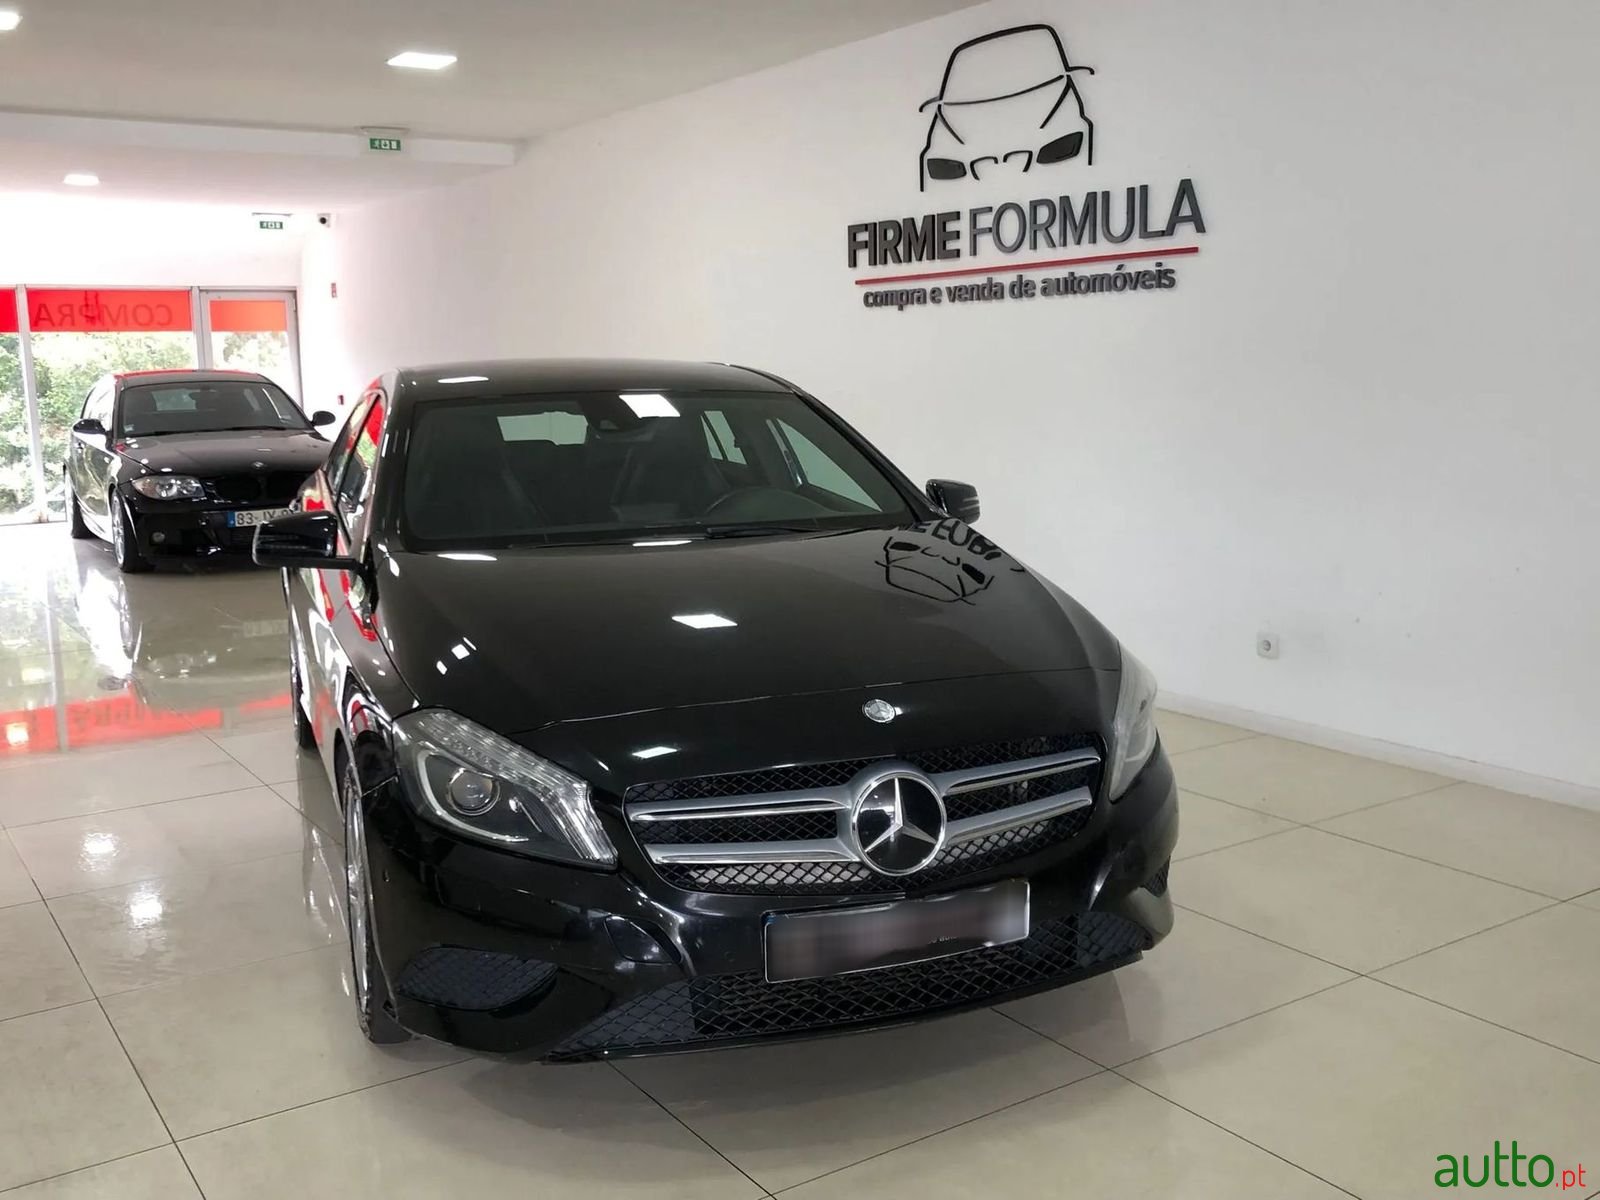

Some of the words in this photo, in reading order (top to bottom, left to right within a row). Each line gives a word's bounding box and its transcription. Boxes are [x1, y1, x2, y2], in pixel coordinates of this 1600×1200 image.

[848, 210, 961, 268] FIRME
[969, 178, 1207, 256] FORMULA
[863, 285, 928, 311] compra
[930, 286, 942, 304] e
[946, 276, 1005, 304] venda
[1009, 273, 1036, 299] de
[1040, 261, 1176, 297] automóveis
